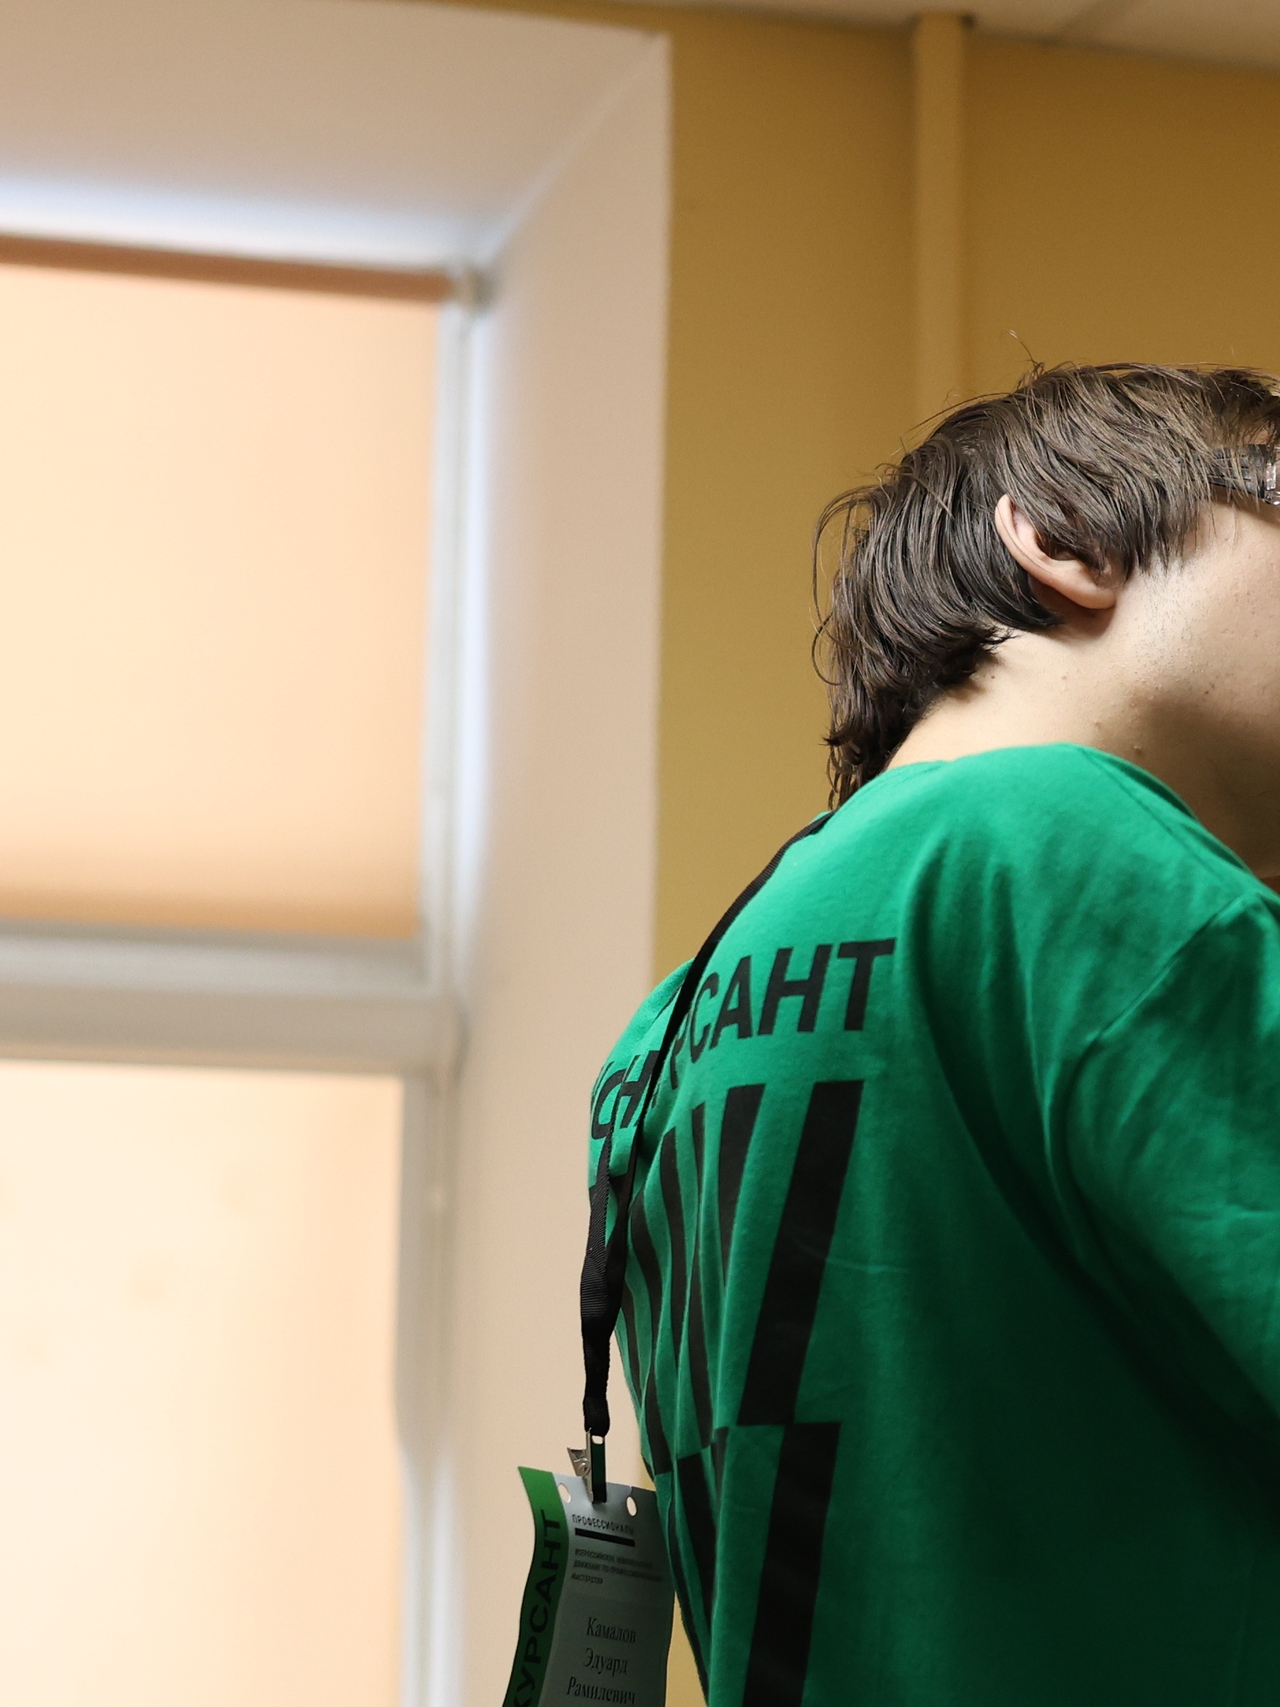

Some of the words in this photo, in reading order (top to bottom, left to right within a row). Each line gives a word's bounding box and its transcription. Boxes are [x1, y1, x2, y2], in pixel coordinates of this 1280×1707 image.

[586, 1616, 637, 1644] Камалов
[584, 1648, 628, 1677] Эдуард
[566, 1676, 637, 1706] Рамилевич
